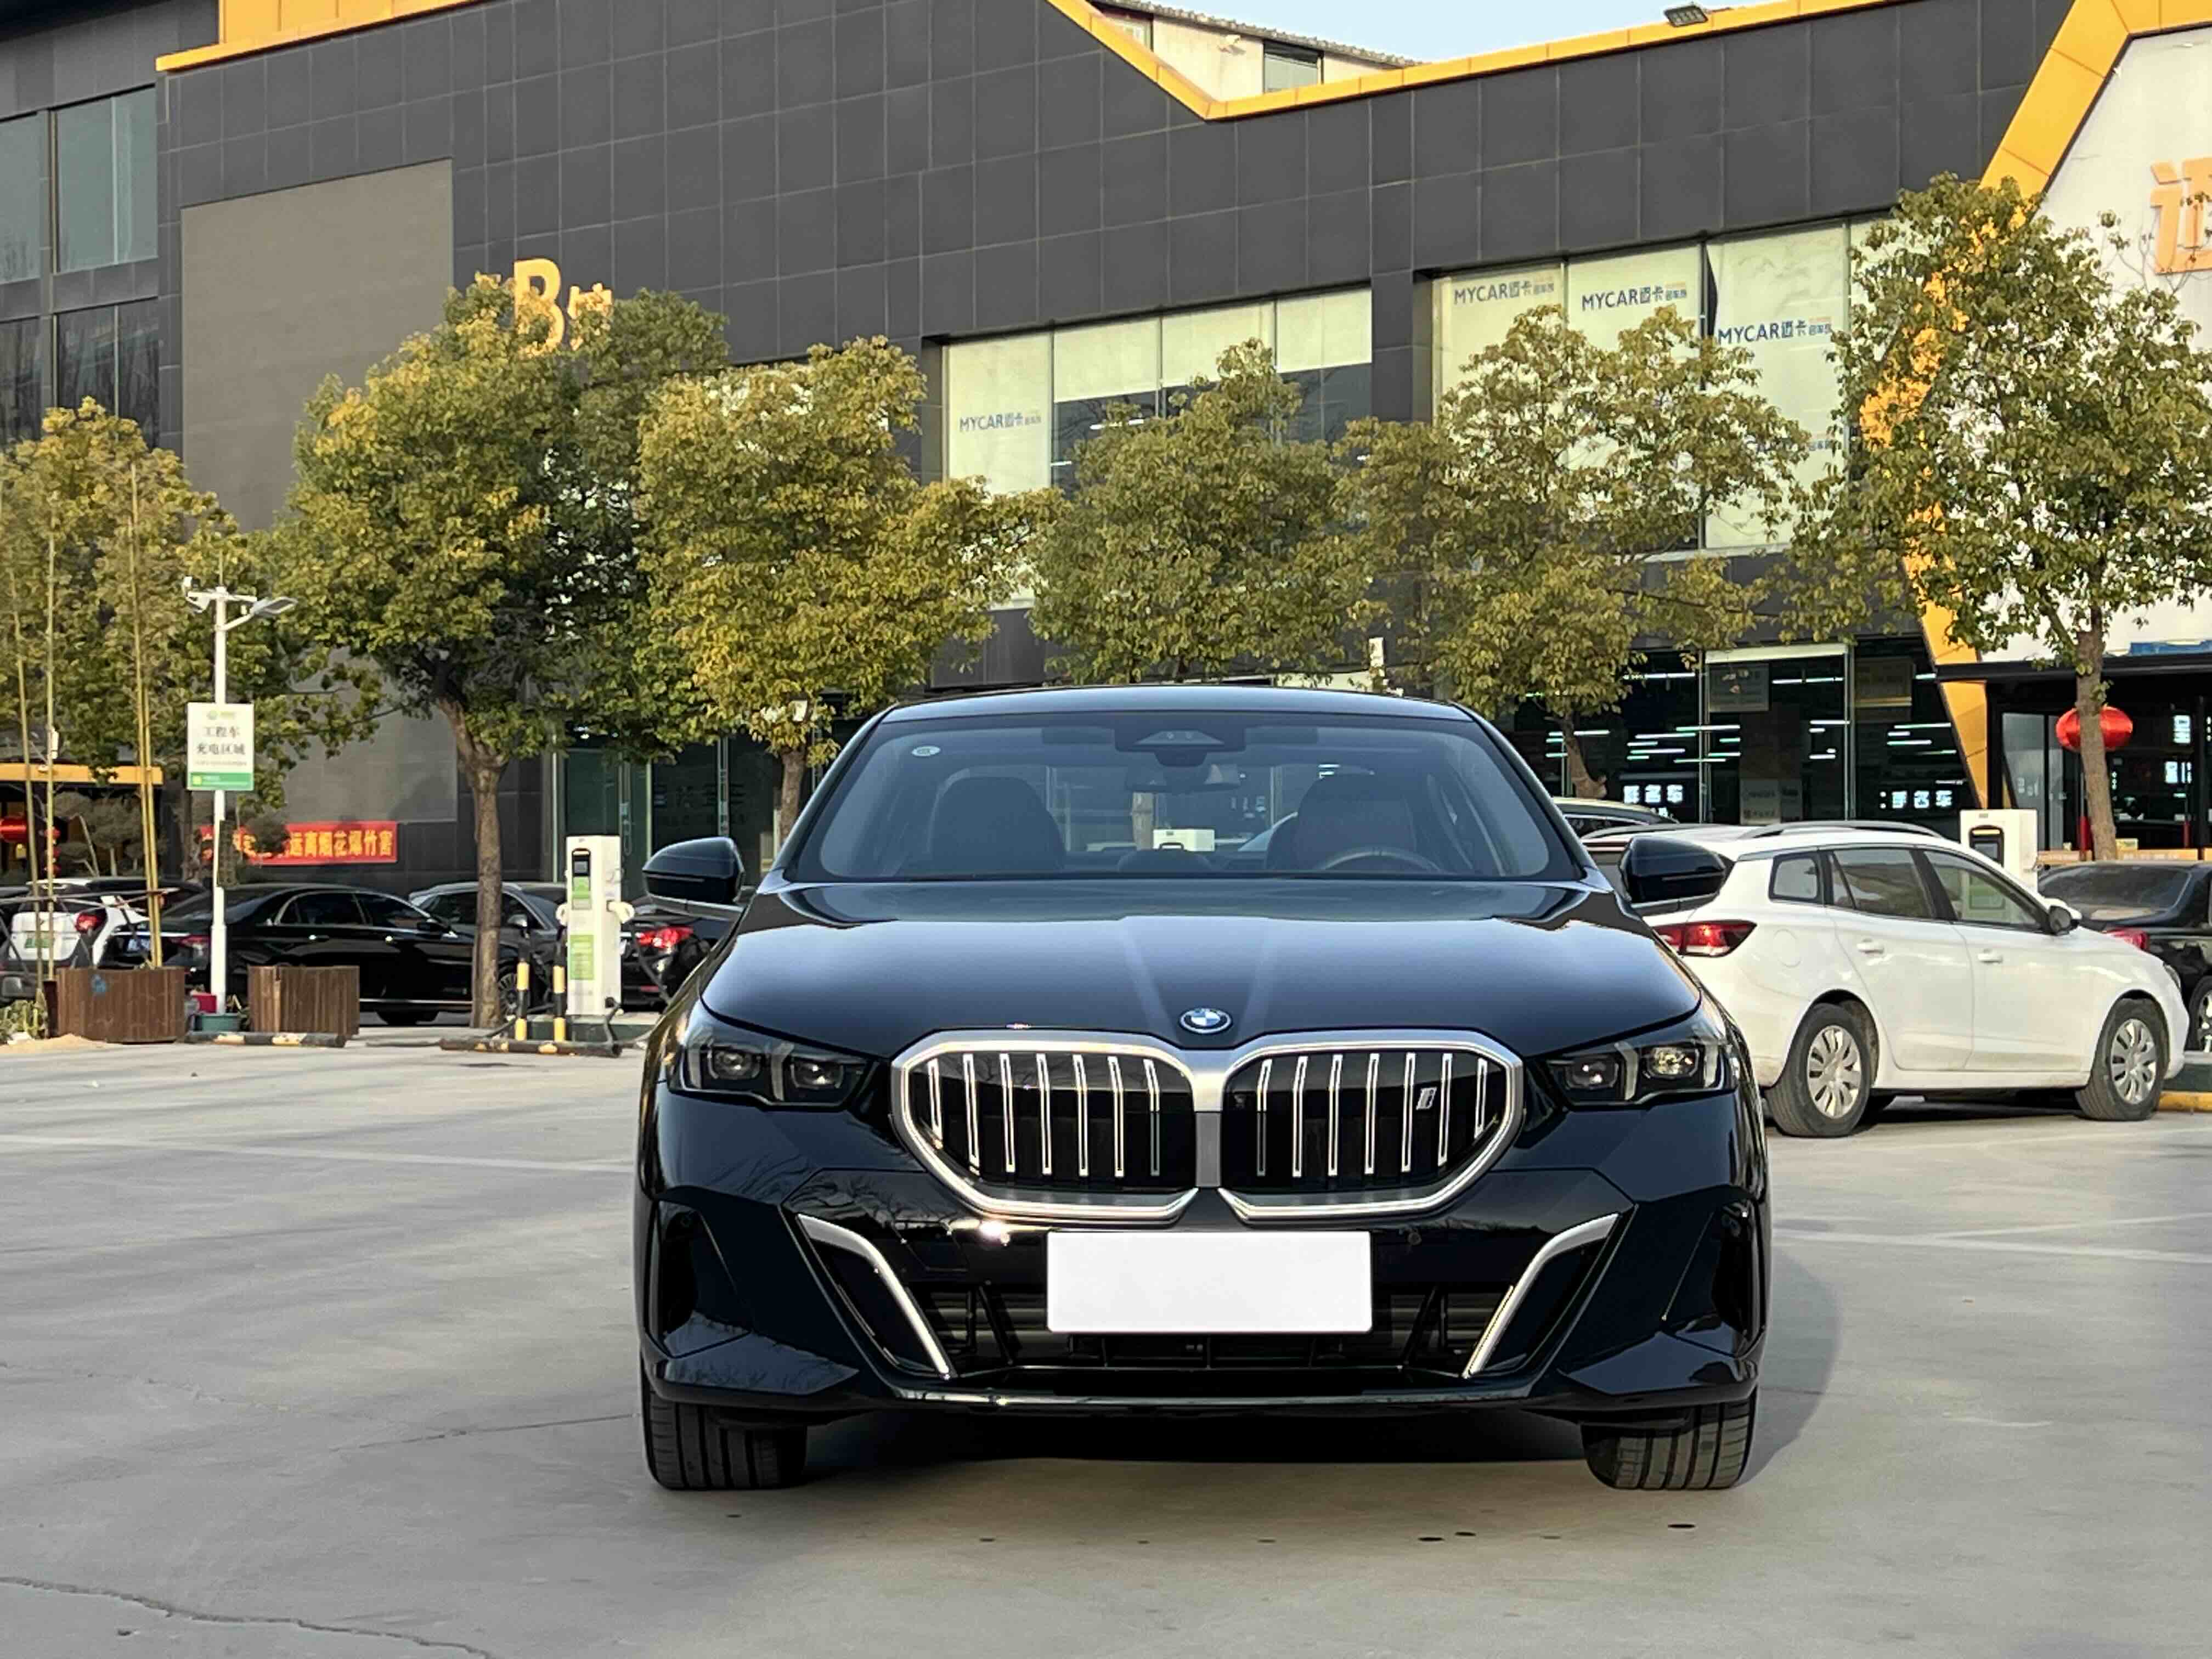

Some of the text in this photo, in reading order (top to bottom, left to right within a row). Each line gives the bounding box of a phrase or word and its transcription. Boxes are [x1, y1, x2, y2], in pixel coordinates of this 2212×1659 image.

[1454, 283, 1508, 305] MYCAR
[1582, 289, 1638, 312] MYCAR
[1718, 323, 1780, 345] MYCAR
[959, 414, 1003, 432] MYCAR
